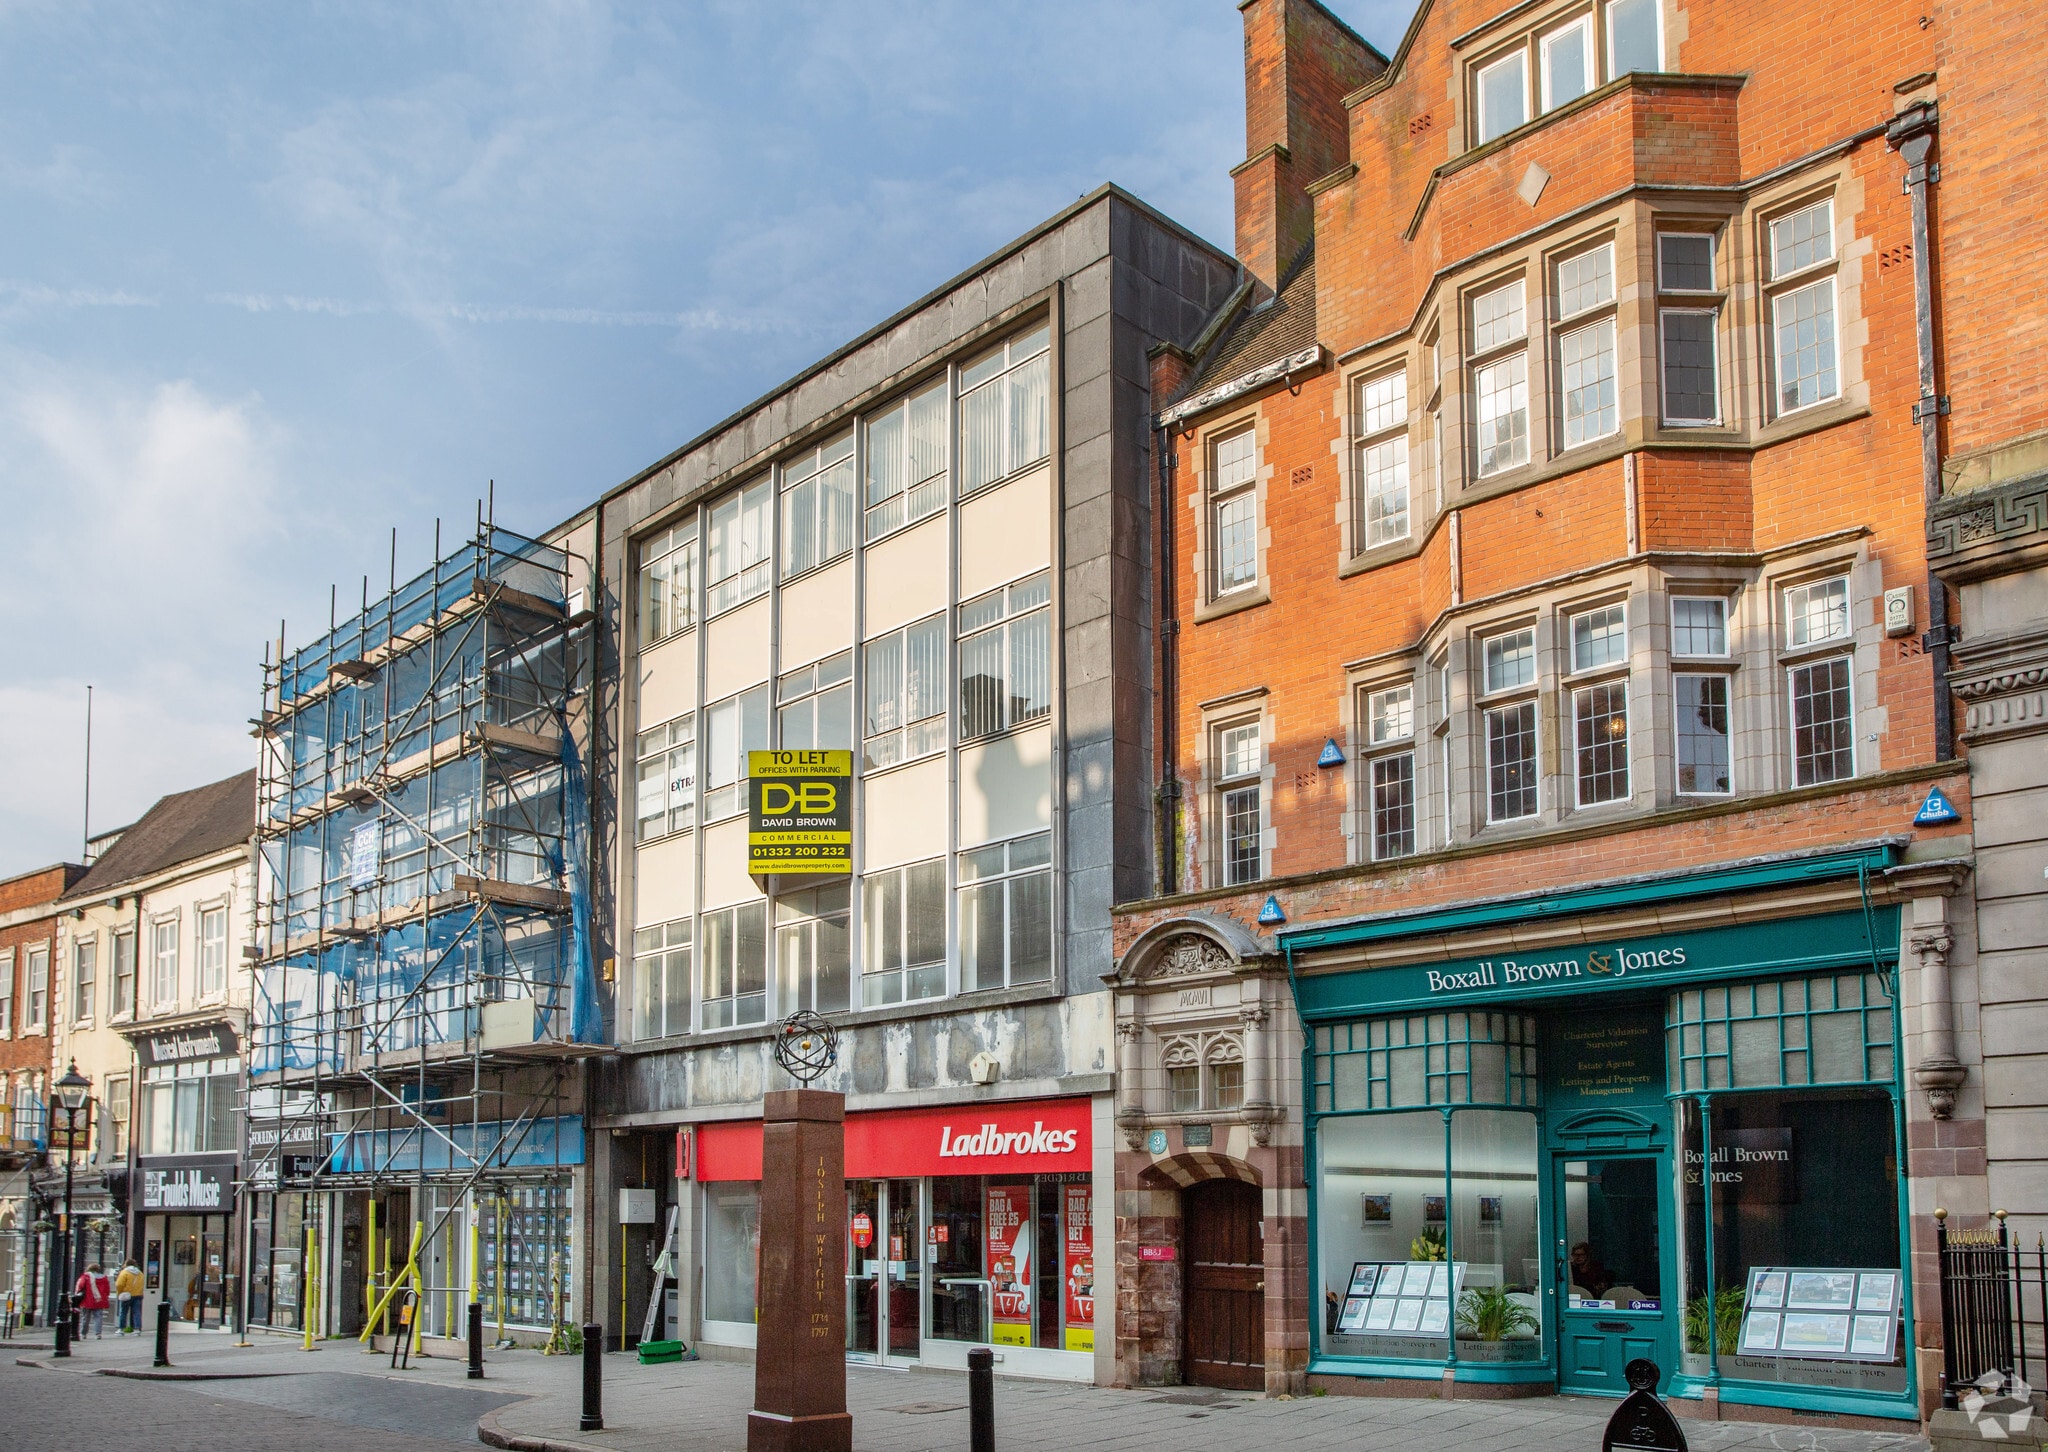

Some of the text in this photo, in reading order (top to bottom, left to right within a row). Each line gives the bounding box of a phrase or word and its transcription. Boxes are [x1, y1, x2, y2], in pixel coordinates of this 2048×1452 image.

[771, 752, 829, 764] TO LET
[789, 766, 808, 774] WITH
[810, 766, 840, 774] PARKING
[1920, 809, 1949, 819] Chubb
[762, 818, 836, 827] DAVID BROWN
[753, 847, 845, 856] 01332 200 232
[1426, 947, 1686, 992] Boxall Brown & Jones
[1586, 1040, 1628, 1049] Surveyors
[1578, 1060, 1635, 1070] Estate Agents
[1596, 1075, 1611, 1084] and
[1614, 1074, 1651, 1085] Property
[1580, 1086, 1634, 1096] Management
[939, 1121, 1077, 1157] Ladbrokes
[1154, 1136, 1160, 1145] 3
[1734, 1147, 1789, 1162] Brown
[1684, 1168, 1699, 1183] &
[158, 1171, 189, 1207] Foulds
[189, 1170, 220, 1206] Music
[989, 1199, 1012, 1212] BAG A
[1068, 1198, 1085, 1212] BAG
[989, 1212, 1019, 1226] FREE £5
[1068, 1212, 1087, 1226] FREE
[990, 1226, 1003, 1240] BET
[1068, 1227, 1083, 1240] BET
[1463, 1342, 1495, 1351] Lettings
